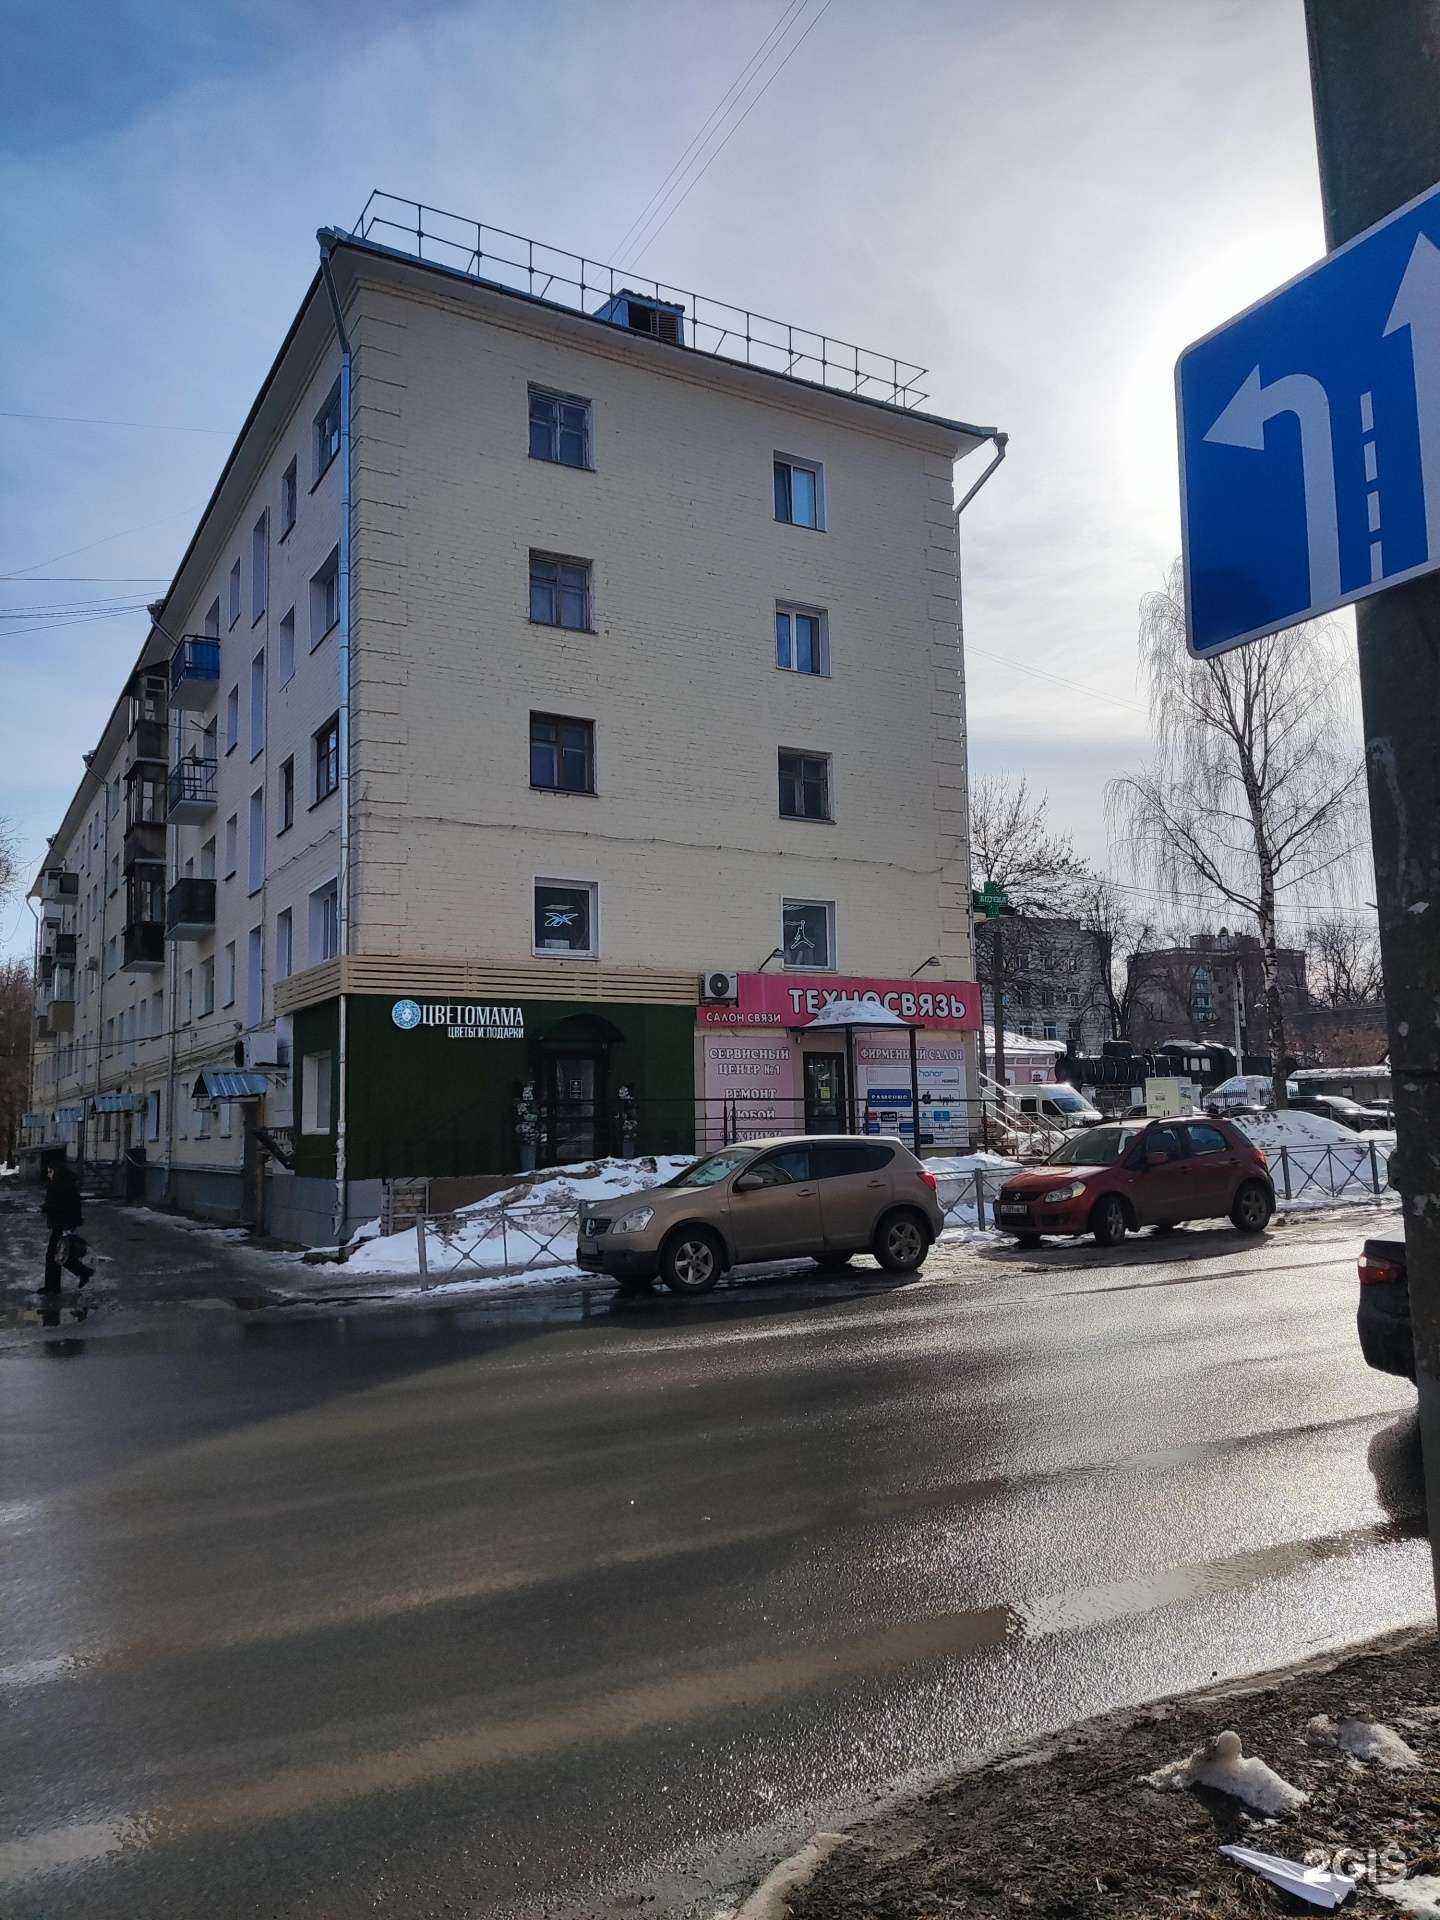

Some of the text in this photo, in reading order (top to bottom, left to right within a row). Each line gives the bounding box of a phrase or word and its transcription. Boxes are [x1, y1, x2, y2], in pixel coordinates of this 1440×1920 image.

[422, 1004, 524, 1026] ЦВЕТОМАМА
[706, 1011, 782, 1023] САЛОН СВЯЗИ
[448, 1026, 524, 1040] ЦВЕТЫ И ПОДАРКИ
[709, 1047, 790, 1060] СЕРВИСНЫЙ
[928, 1048, 963, 1060] САЛОН
[718, 1064, 760, 1076] ЦЕНТР
[725, 1089, 777, 1099] РЕМОНТ
